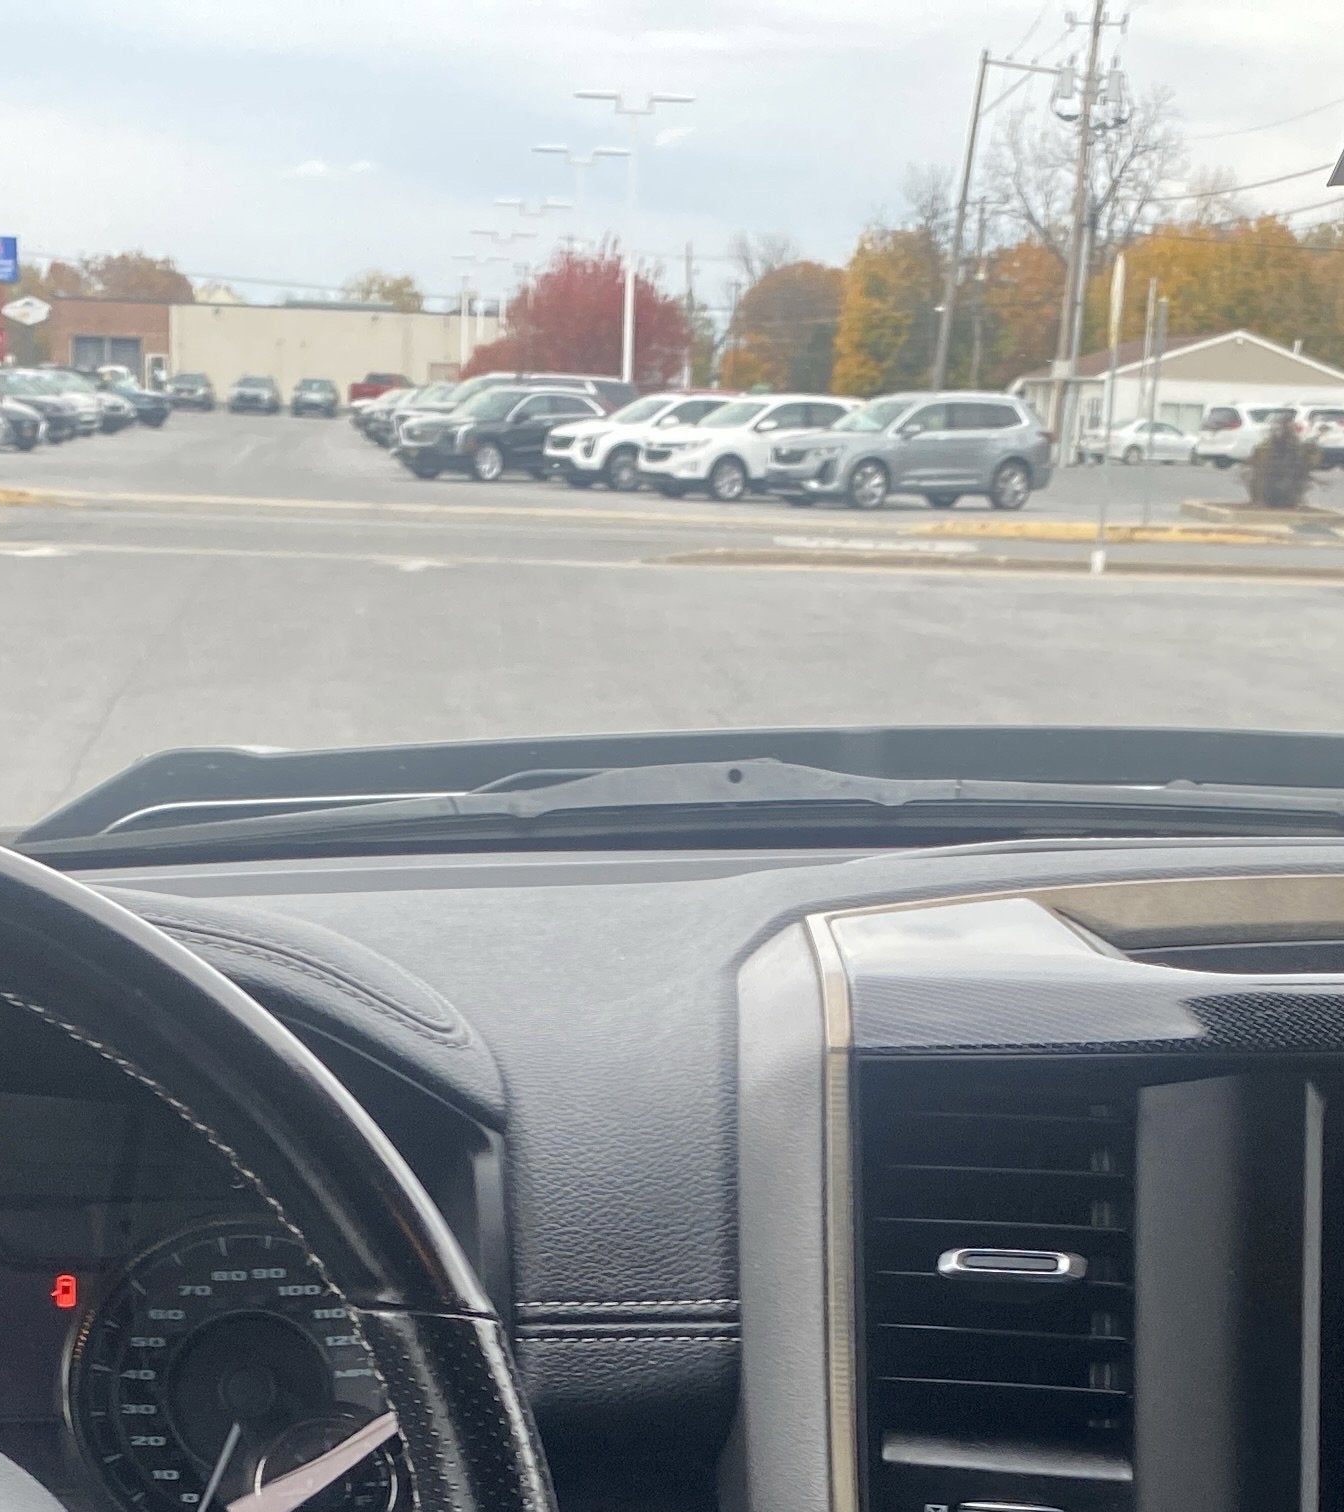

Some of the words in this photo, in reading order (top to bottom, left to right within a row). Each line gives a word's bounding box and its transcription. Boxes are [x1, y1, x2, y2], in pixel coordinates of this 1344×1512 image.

[210, 1270, 248, 1282] 80
[250, 1267, 288, 1280] 90
[176, 1284, 213, 1297] 70
[277, 1284, 322, 1297] 100
[148, 1308, 186, 1321] 60
[313, 1307, 347, 1320] 110
[129, 1336, 166, 1348] 50
[119, 1368, 157, 1381] 40
[120, 1403, 157, 1415] 30
[130, 1434, 167, 1447] 20
[151, 1469, 181, 1481] 10
[180, 1492, 200, 1503] 0
